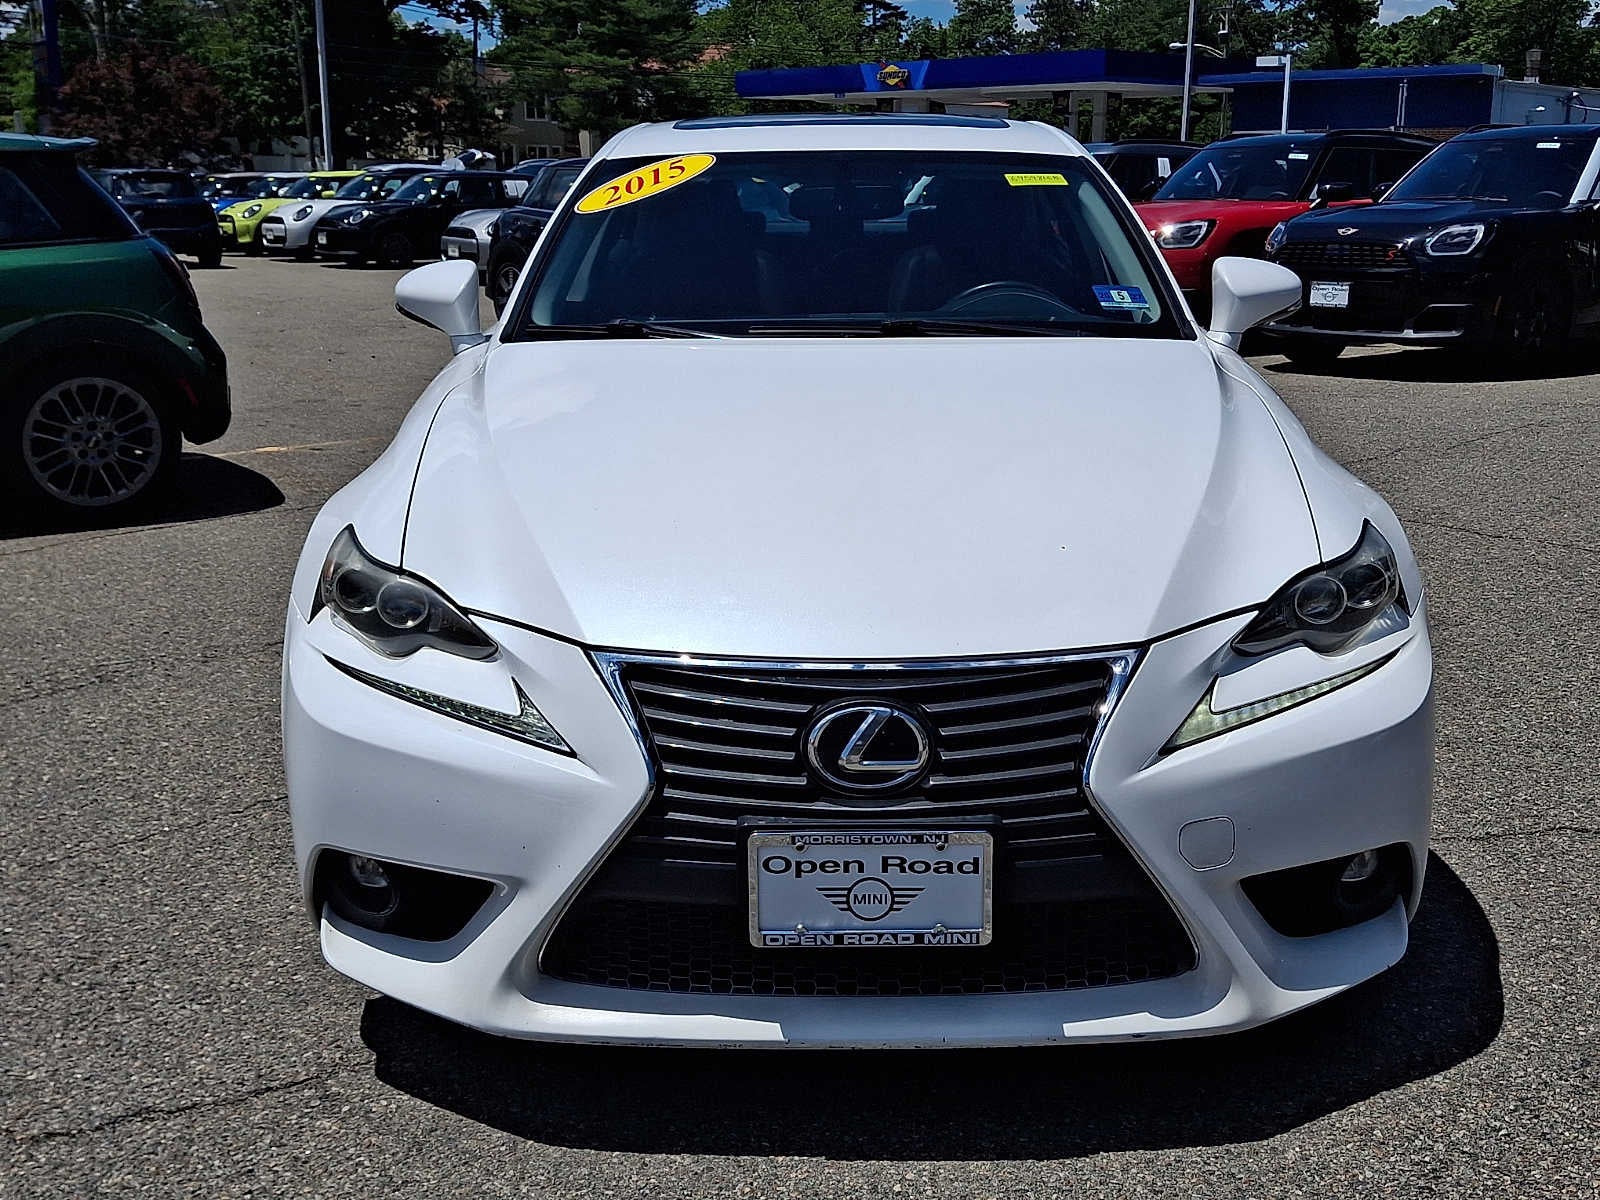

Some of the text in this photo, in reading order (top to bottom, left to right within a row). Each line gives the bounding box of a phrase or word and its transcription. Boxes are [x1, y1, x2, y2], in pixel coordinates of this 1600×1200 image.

[878, 71, 907, 80] SUNOCO
[603, 159, 686, 205] 2015
[1117, 291, 1125, 300] 5
[923, 835, 945, 843] NJ
[762, 855, 980, 878] Open Road
[853, 894, 888, 905] MINI
[765, 933, 977, 946] OPEN ROAD MINI
